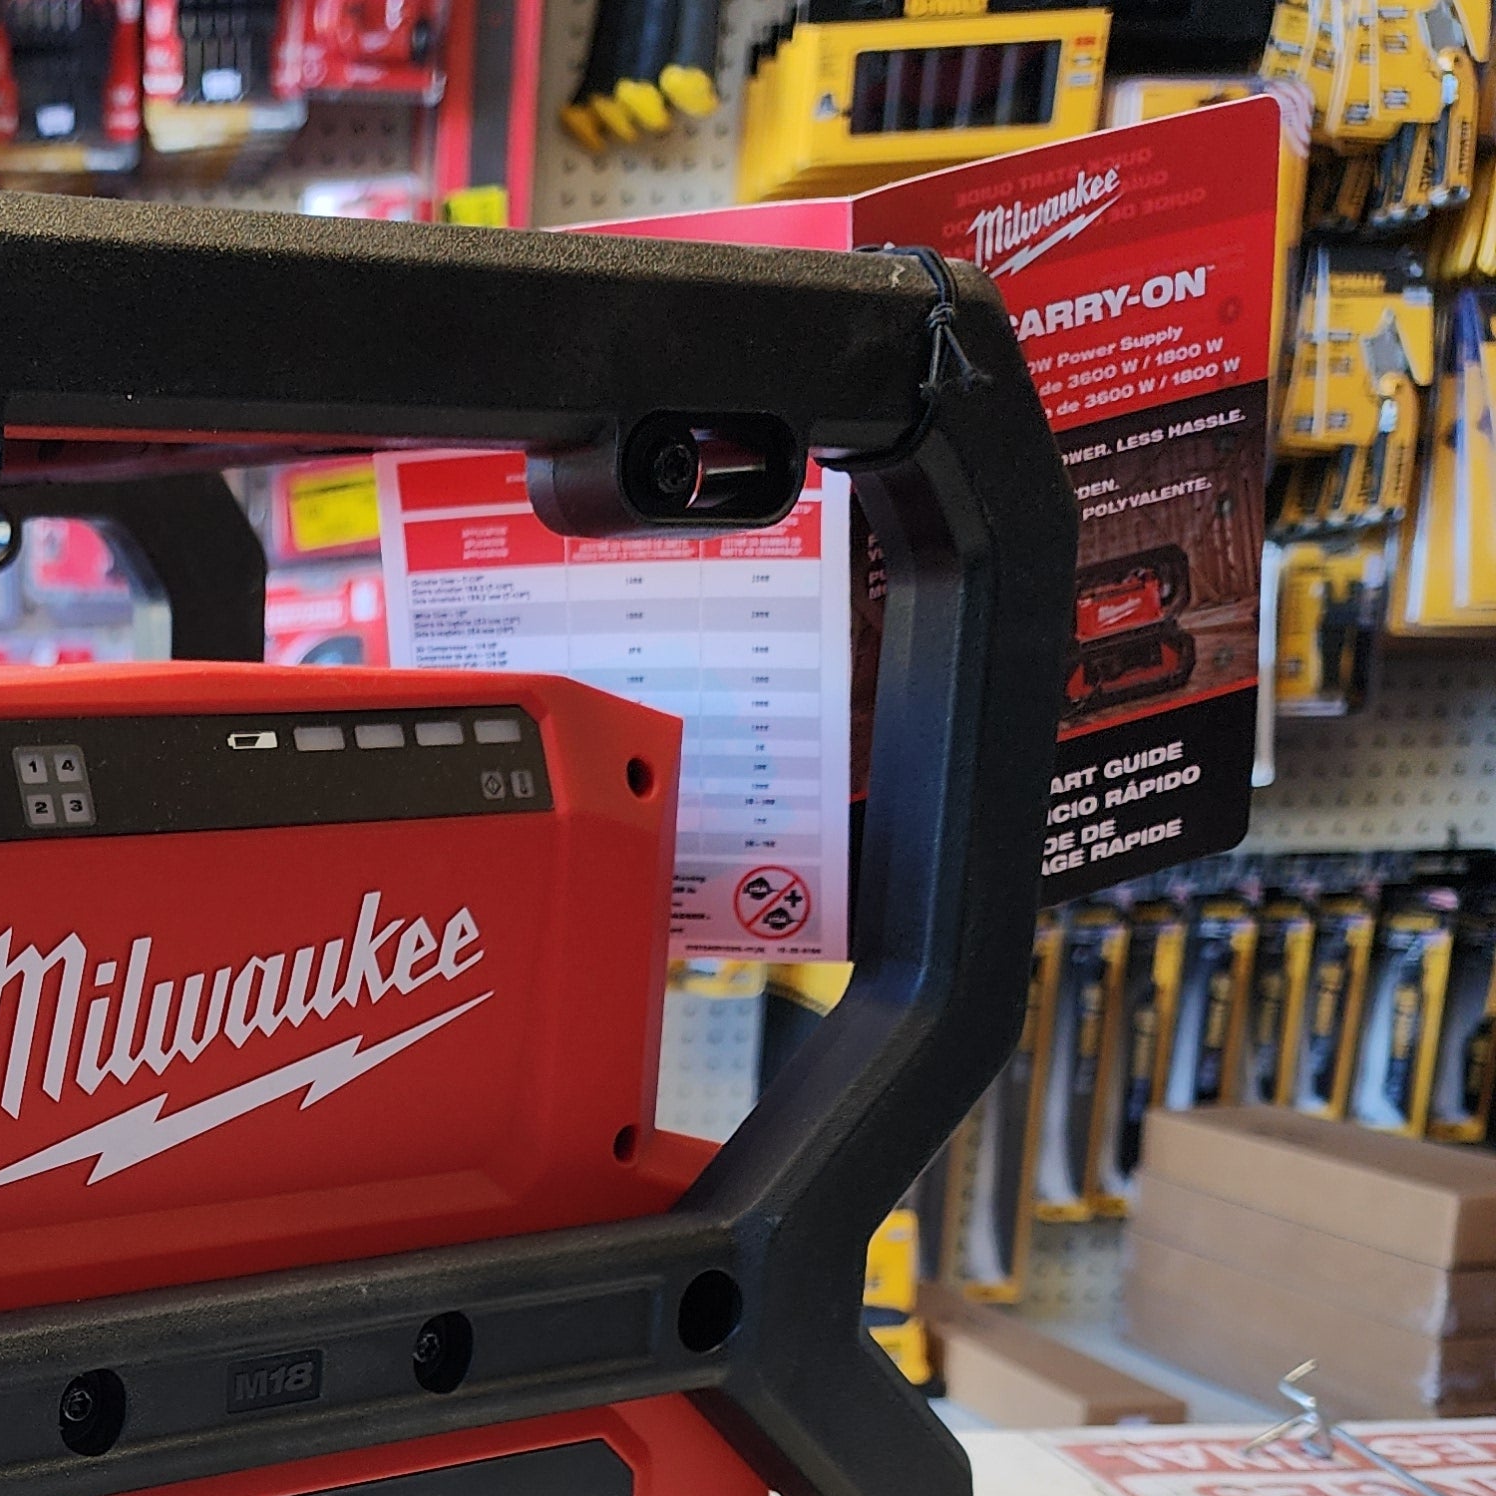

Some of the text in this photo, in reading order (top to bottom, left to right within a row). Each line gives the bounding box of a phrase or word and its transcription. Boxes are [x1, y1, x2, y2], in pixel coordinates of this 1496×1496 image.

[966, 167, 1121, 268] Milwaukee
[1039, 380, 1063, 397] de
[1068, 367, 1117, 389] 3600
[1121, 359, 1139, 374] W
[1155, 344, 1202, 367] 1800
[1206, 338, 1224, 353] W
[1057, 343, 1116, 369] Power
[1120, 325, 1183, 351] Supply
[1056, 401, 1080, 416] de
[1085, 386, 1134, 409] 3600
[1139, 378, 1156, 394] W
[1171, 364, 1219, 385] 1800
[1223, 357, 1241, 373] W
[1117, 428, 1165, 452] LESS
[1168, 408, 1246, 440] HASSLE.
[1074, 478, 1121, 501] DEN.
[1082, 476, 1212, 521] POLYVALENTE.
[29, 760, 75, 773] 1 4
[1050, 740, 1184, 795] ART GUIDE
[35, 799, 83, 814] 2 3
[1046, 764, 1201, 827] ICIO RÁPIDO
[1043, 818, 1117, 856] DE DE
[1090, 817, 1184, 862] RAPIDE
[235, 1361, 313, 1400] M18
